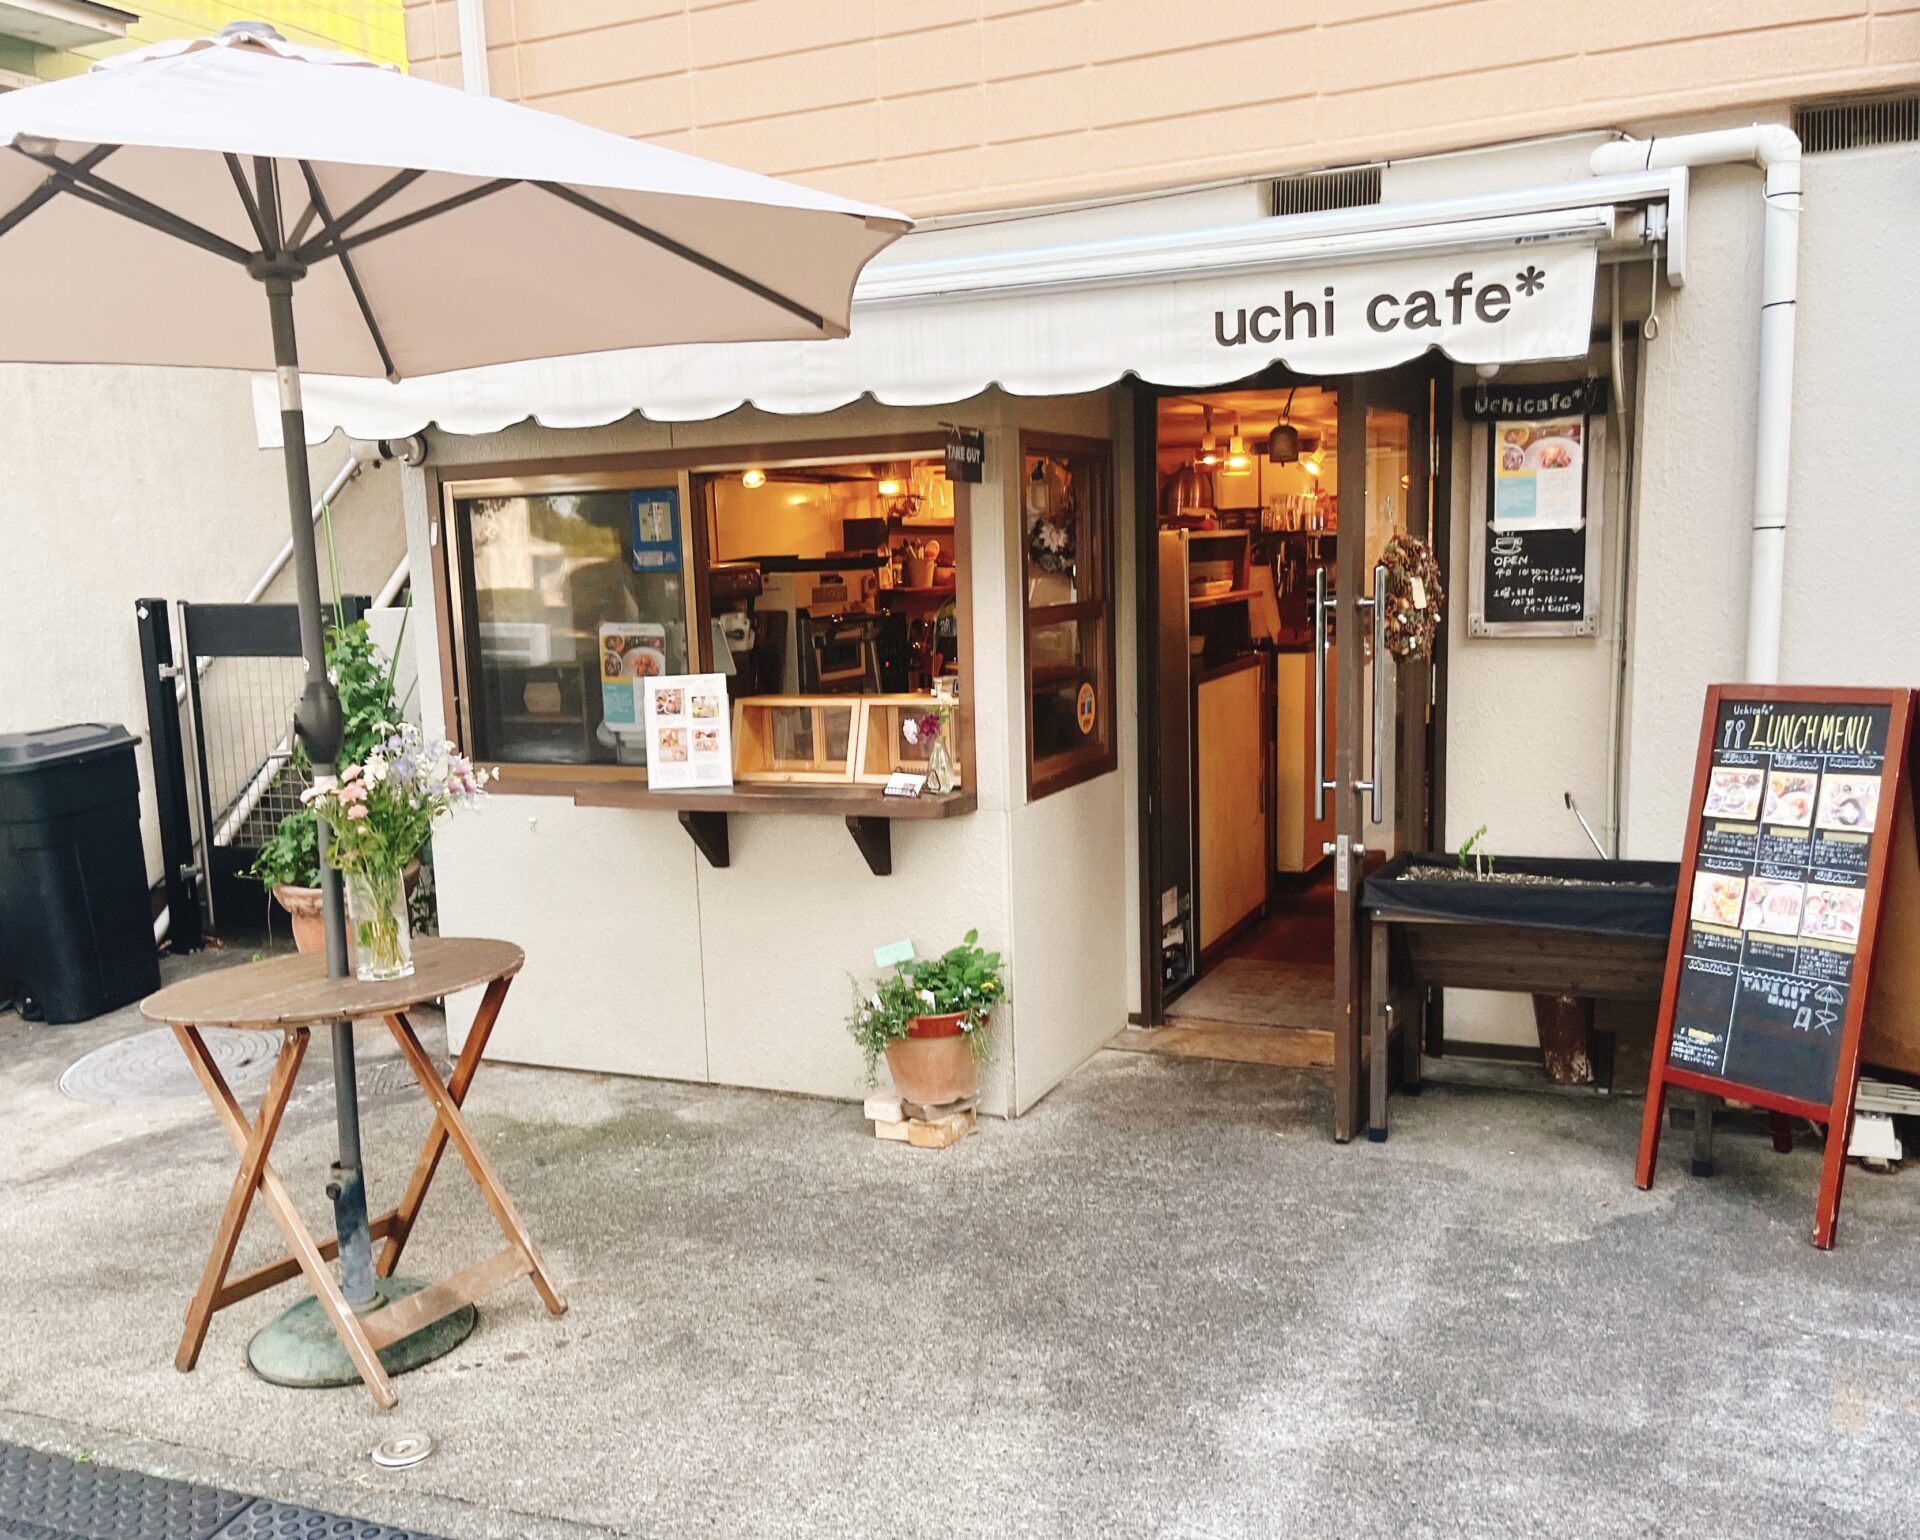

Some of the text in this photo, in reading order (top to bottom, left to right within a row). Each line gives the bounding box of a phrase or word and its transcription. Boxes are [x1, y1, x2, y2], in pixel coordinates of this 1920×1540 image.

[1214, 286, 1335, 347] uchi
[946, 444, 981, 465] TAKE OUT
[1493, 555, 1529, 568] OPEN
[1748, 713, 1873, 752] LUNCH MENU
[1741, 975, 1811, 1002] TAKE OUT
